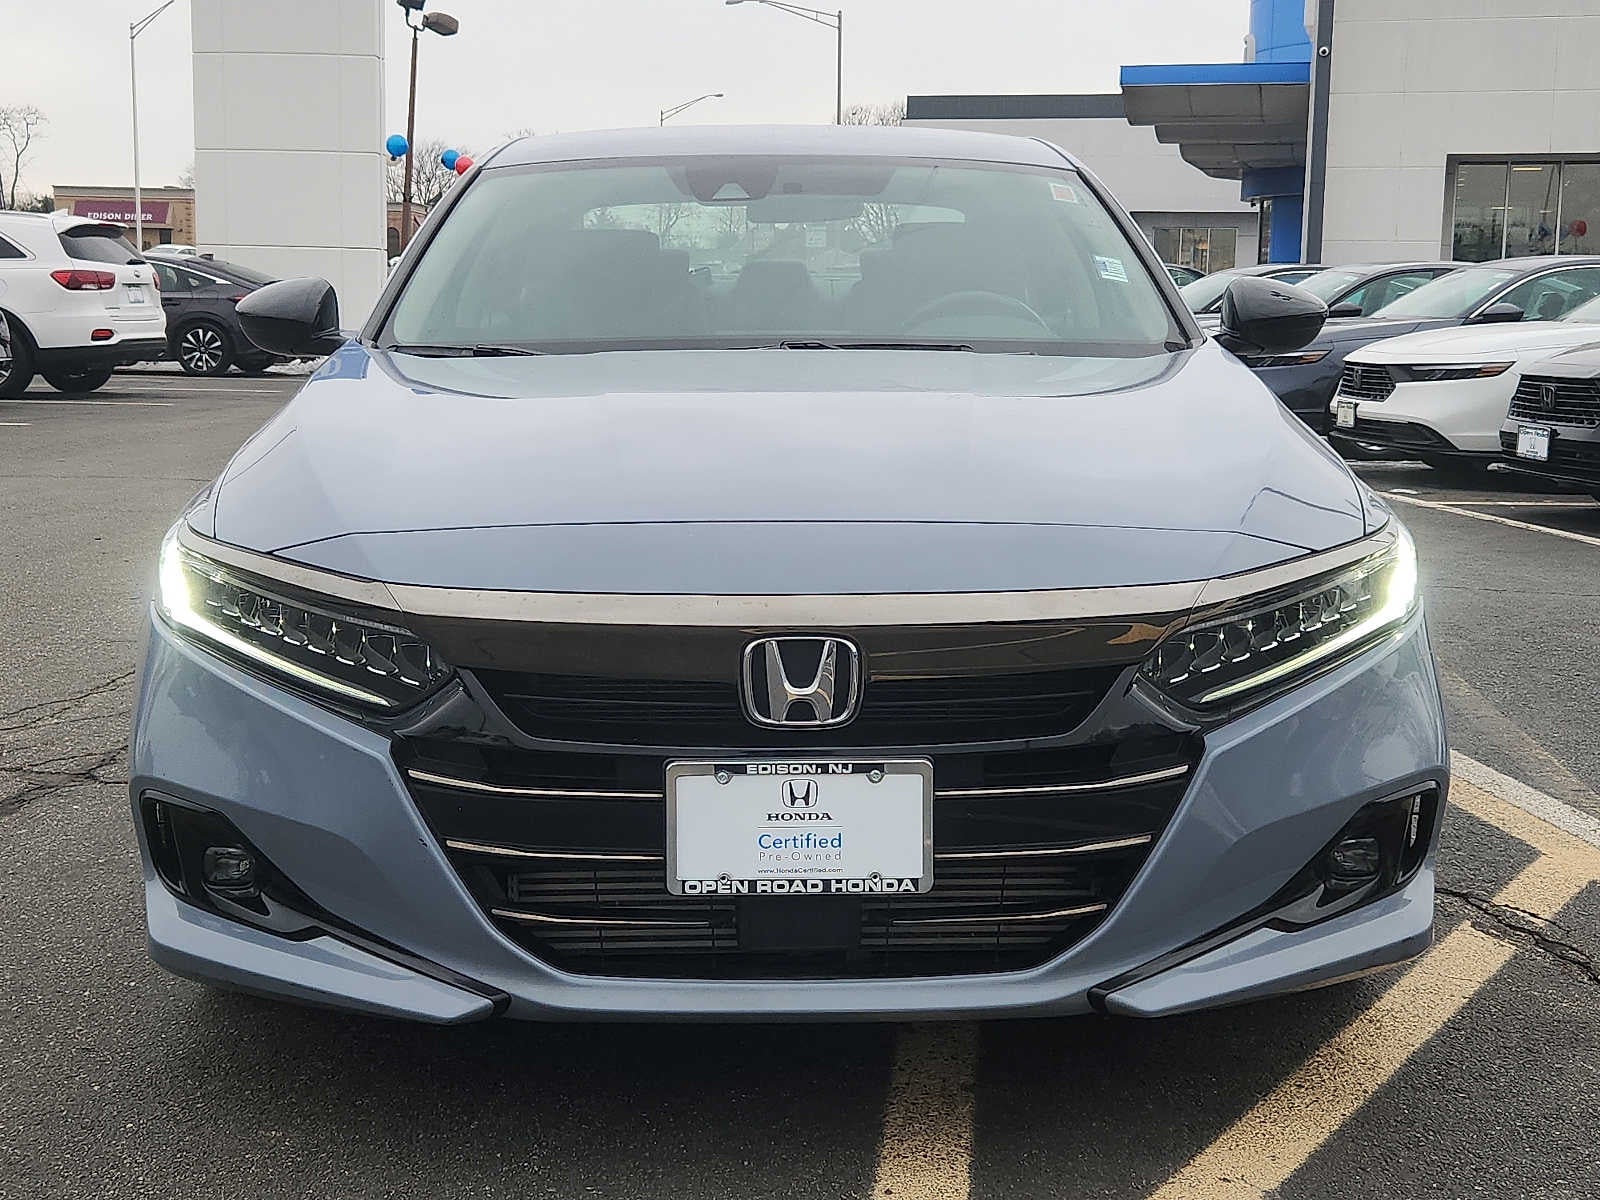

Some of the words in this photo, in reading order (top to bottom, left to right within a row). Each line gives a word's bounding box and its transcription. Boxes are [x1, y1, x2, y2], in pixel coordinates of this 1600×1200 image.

[87, 212, 122, 220] EDISON
[124, 213, 153, 221] DIER
[746, 764, 822, 775] EDISON,
[828, 764, 853, 774] NJ
[766, 812, 833, 821] HONDA
[757, 832, 842, 849] Certified
[759, 851, 842, 861] Pre-Owned
[684, 880, 749, 894] OPEN
[756, 879, 823, 893] ROAD
[830, 878, 916, 893] HONDA
